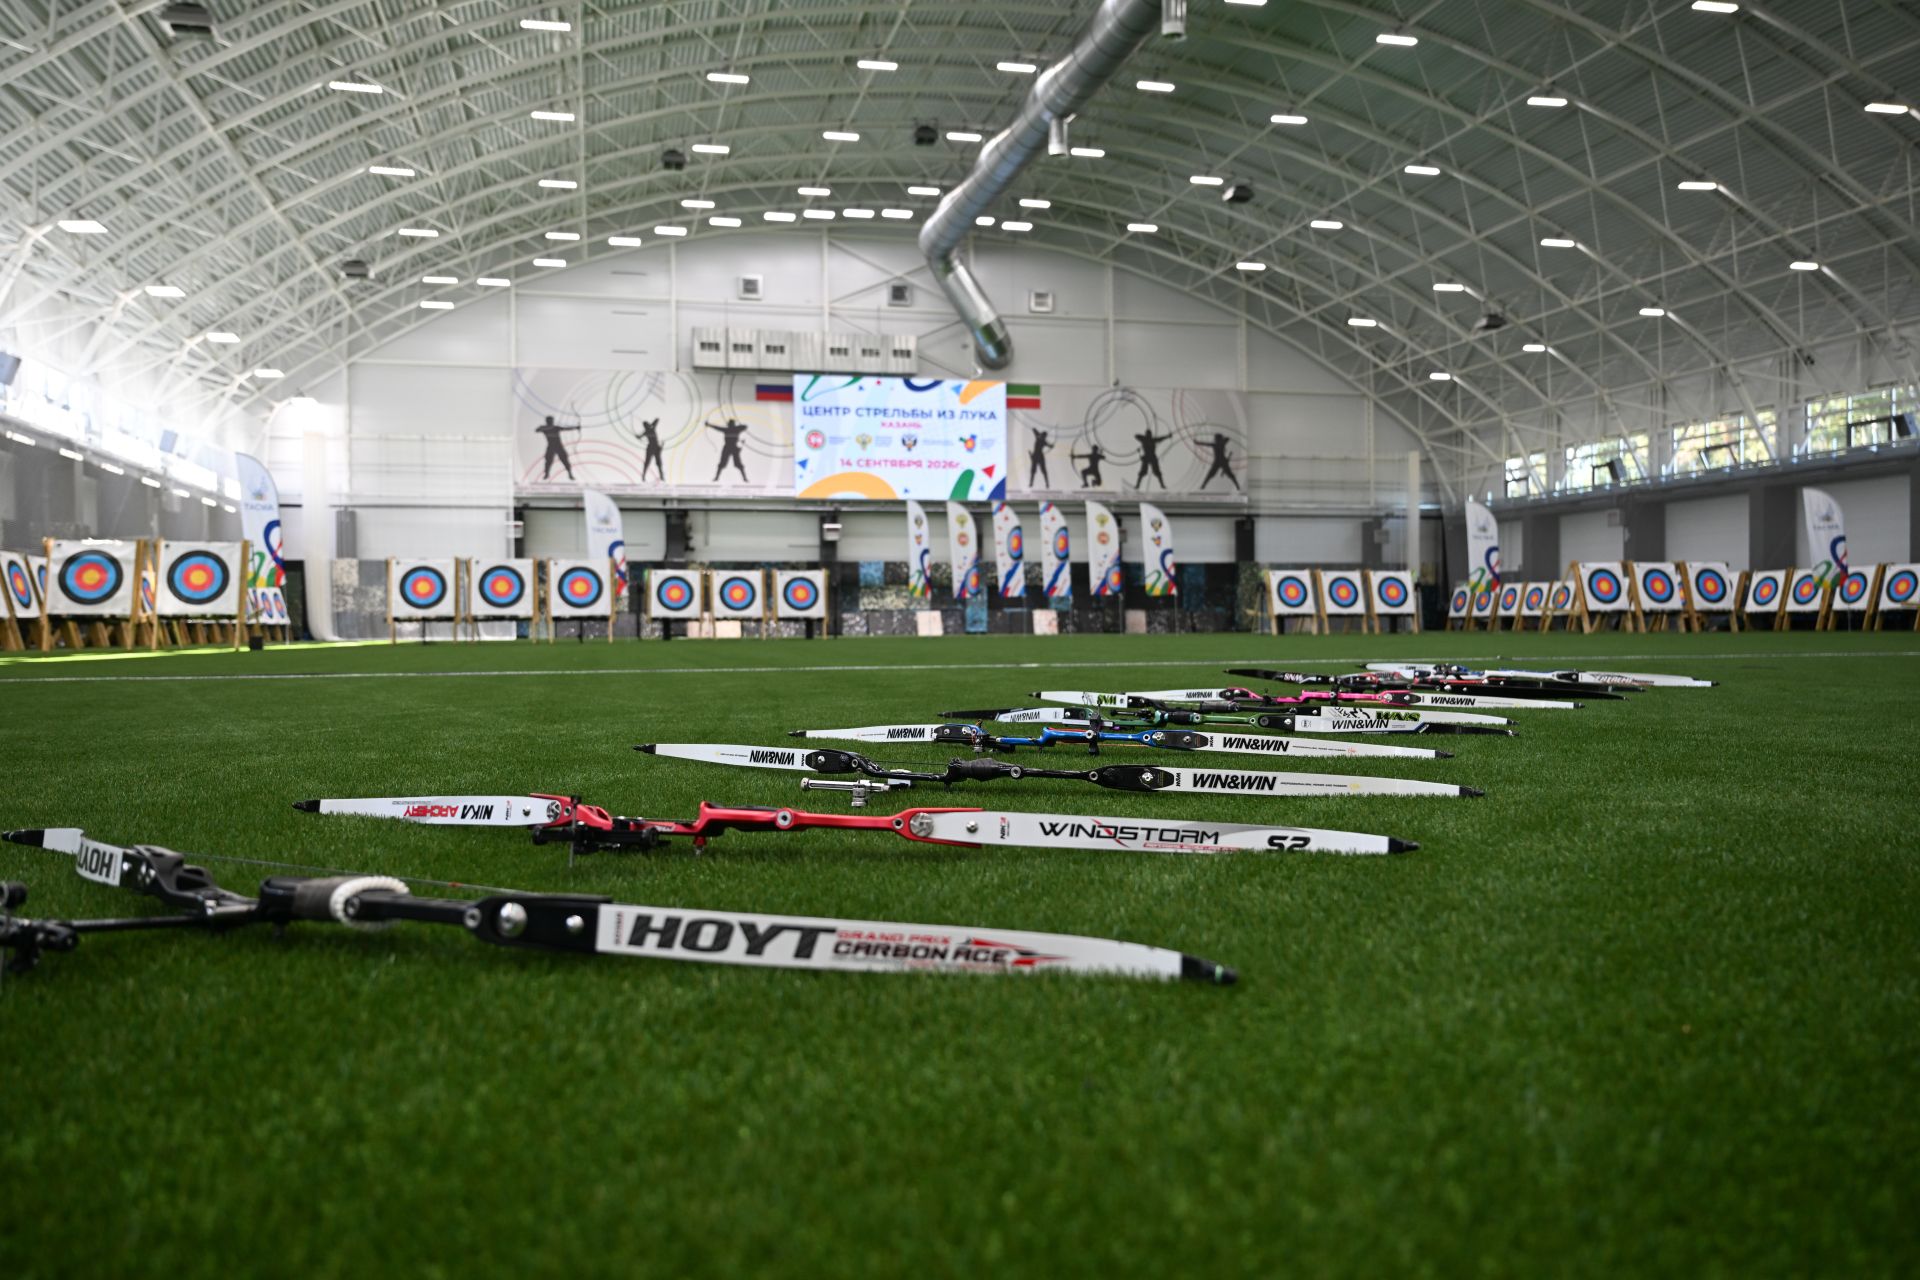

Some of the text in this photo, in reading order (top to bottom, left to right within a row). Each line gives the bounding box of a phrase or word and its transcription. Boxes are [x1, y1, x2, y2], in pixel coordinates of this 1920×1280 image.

[802, 406, 998, 420] ЦЕНТР СТРЕЛЬБЫ ИЗ ЛУКА
[880, 421, 922, 429] КАЗАНЬ
[840, 458, 853, 467] 14
[856, 458, 923, 468] СЕНТЯБРЯ
[1430, 696, 1476, 705] WIN&WIN
[1332, 719, 1390, 730] WIN&WIN
[886, 728, 925, 739] WIN&WIN
[1222, 736, 1290, 752] WIN&WIN
[750, 749, 795, 766] WIN&WIN
[1192, 773, 1277, 791] WIN&WIN
[403, 804, 460, 817] ARCHERY
[460, 804, 494, 820] NIKA
[1038, 821, 1220, 845] WINDSTORM
[1267, 835, 1311, 851] S2
[627, 913, 838, 960] HOYT
[836, 929, 952, 945] GRAND PRIX
[833, 940, 947, 961] CARBON
[951, 946, 1010, 964] ACE
